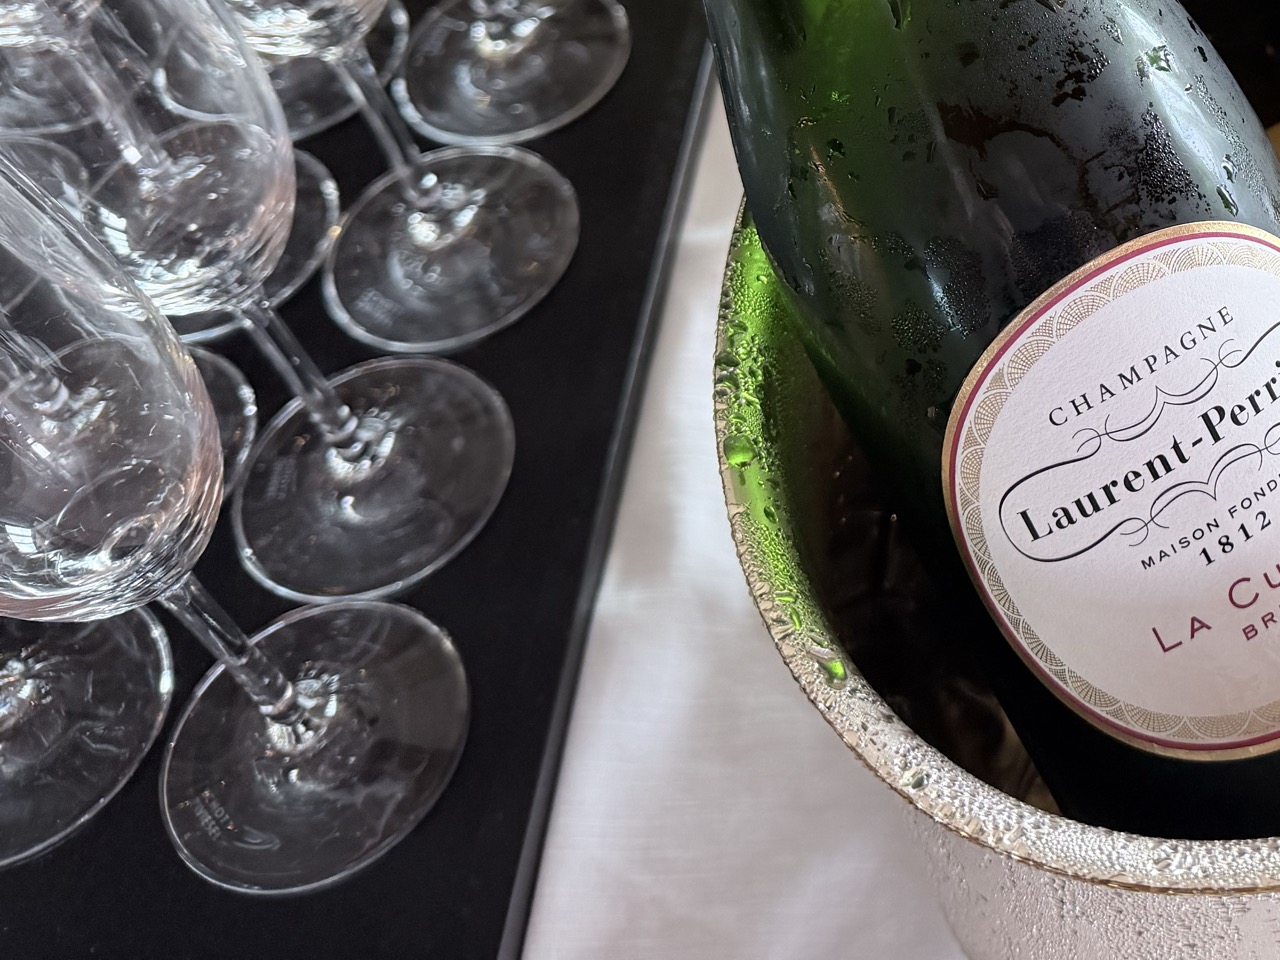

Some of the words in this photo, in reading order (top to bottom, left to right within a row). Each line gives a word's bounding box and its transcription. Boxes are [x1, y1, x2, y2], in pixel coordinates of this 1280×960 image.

[1049, 307, 1233, 426] CHAMPAGNE
[1141, 519, 1219, 569] MAISON
[1200, 511, 1271, 566] 1812
[1152, 616, 1212, 653] LA
